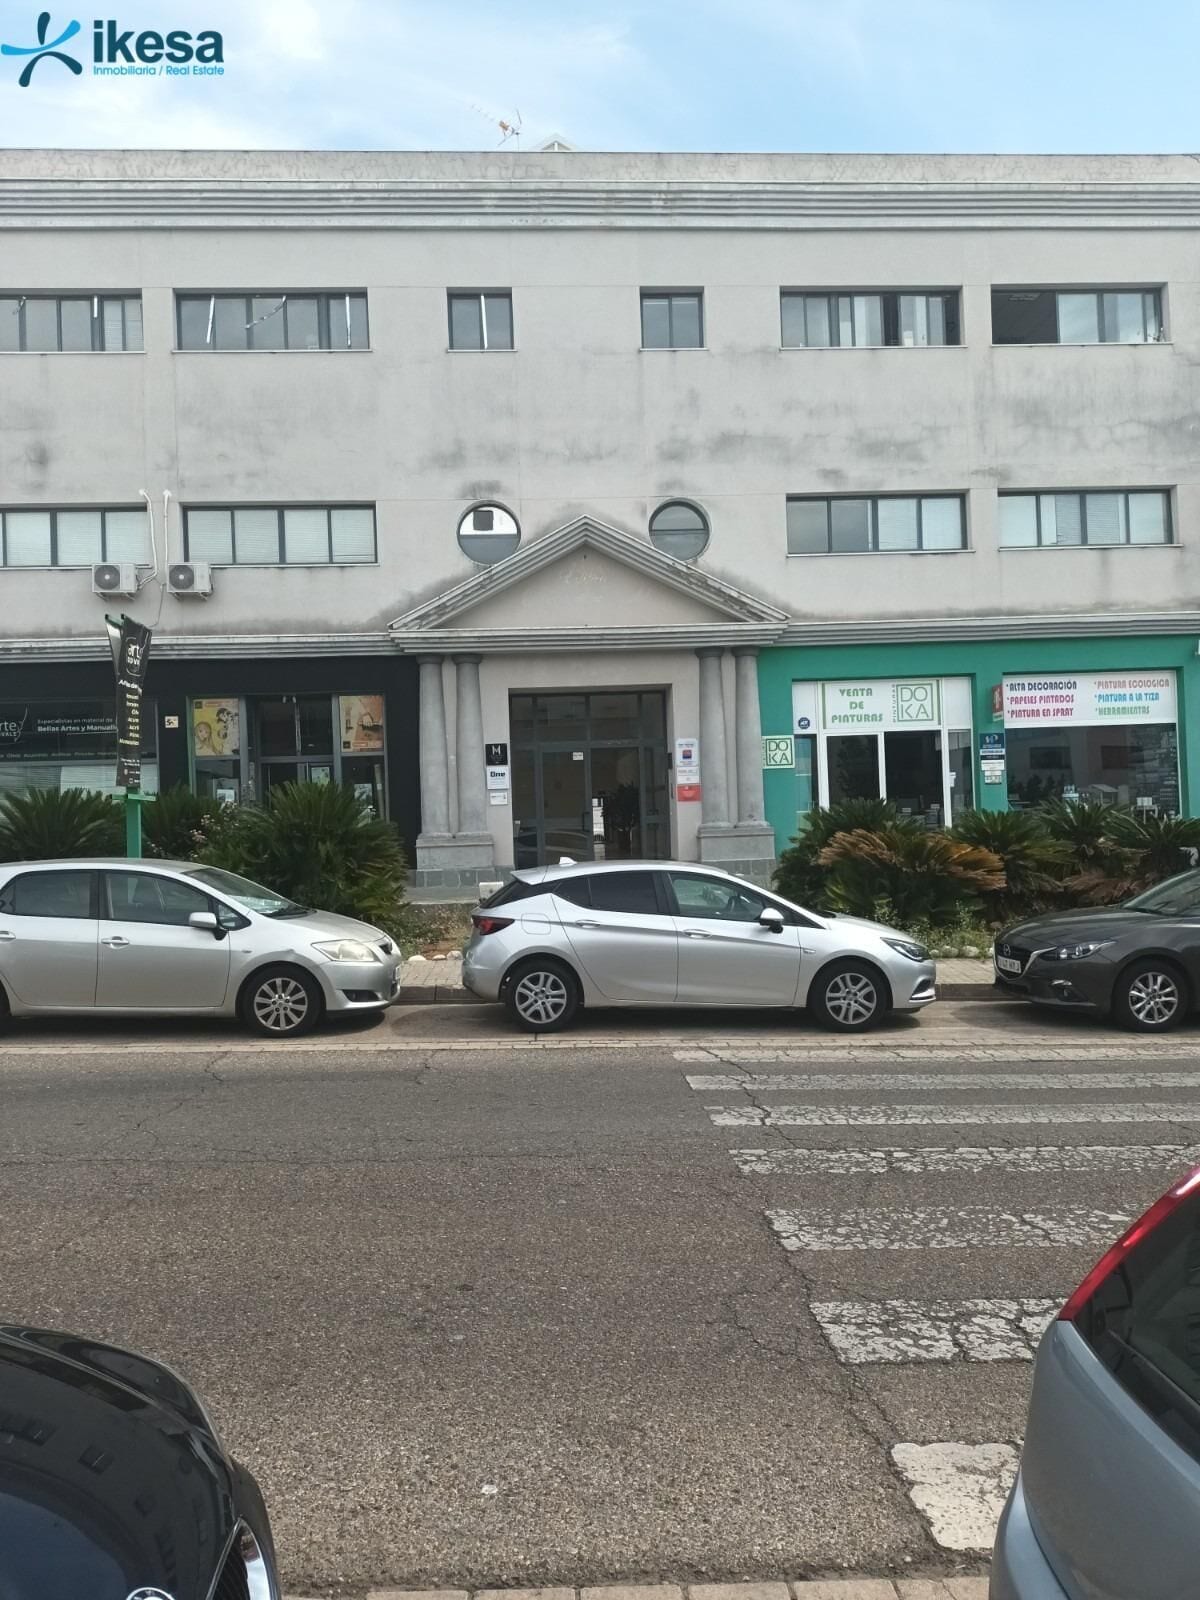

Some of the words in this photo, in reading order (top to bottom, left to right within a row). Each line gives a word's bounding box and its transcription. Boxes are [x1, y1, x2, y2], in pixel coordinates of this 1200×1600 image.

[1009, 683, 1026, 692] ALTA
[1097, 680, 1127, 689] PINTURA
[839, 687, 873, 697] VENTA
[1009, 695, 1037, 705] PAPELES
[1039, 694, 1074, 704] PINTADOS
[1098, 693, 1127, 703] PINTURA
[1129, 693, 1133, 702] A
[1135, 693, 1142, 702] LA
[1144, 692, 1159, 701] TIZA
[849, 701, 864, 710] DE
[1098, 705, 1150, 716] HERRAMIENTAS
[1011, 708, 1040, 718] PINTURA
[1042, 708, 1051, 717] EN
[1052, 707, 1074, 717] SPRAY
[831, 713, 883, 723] PINTURAS
